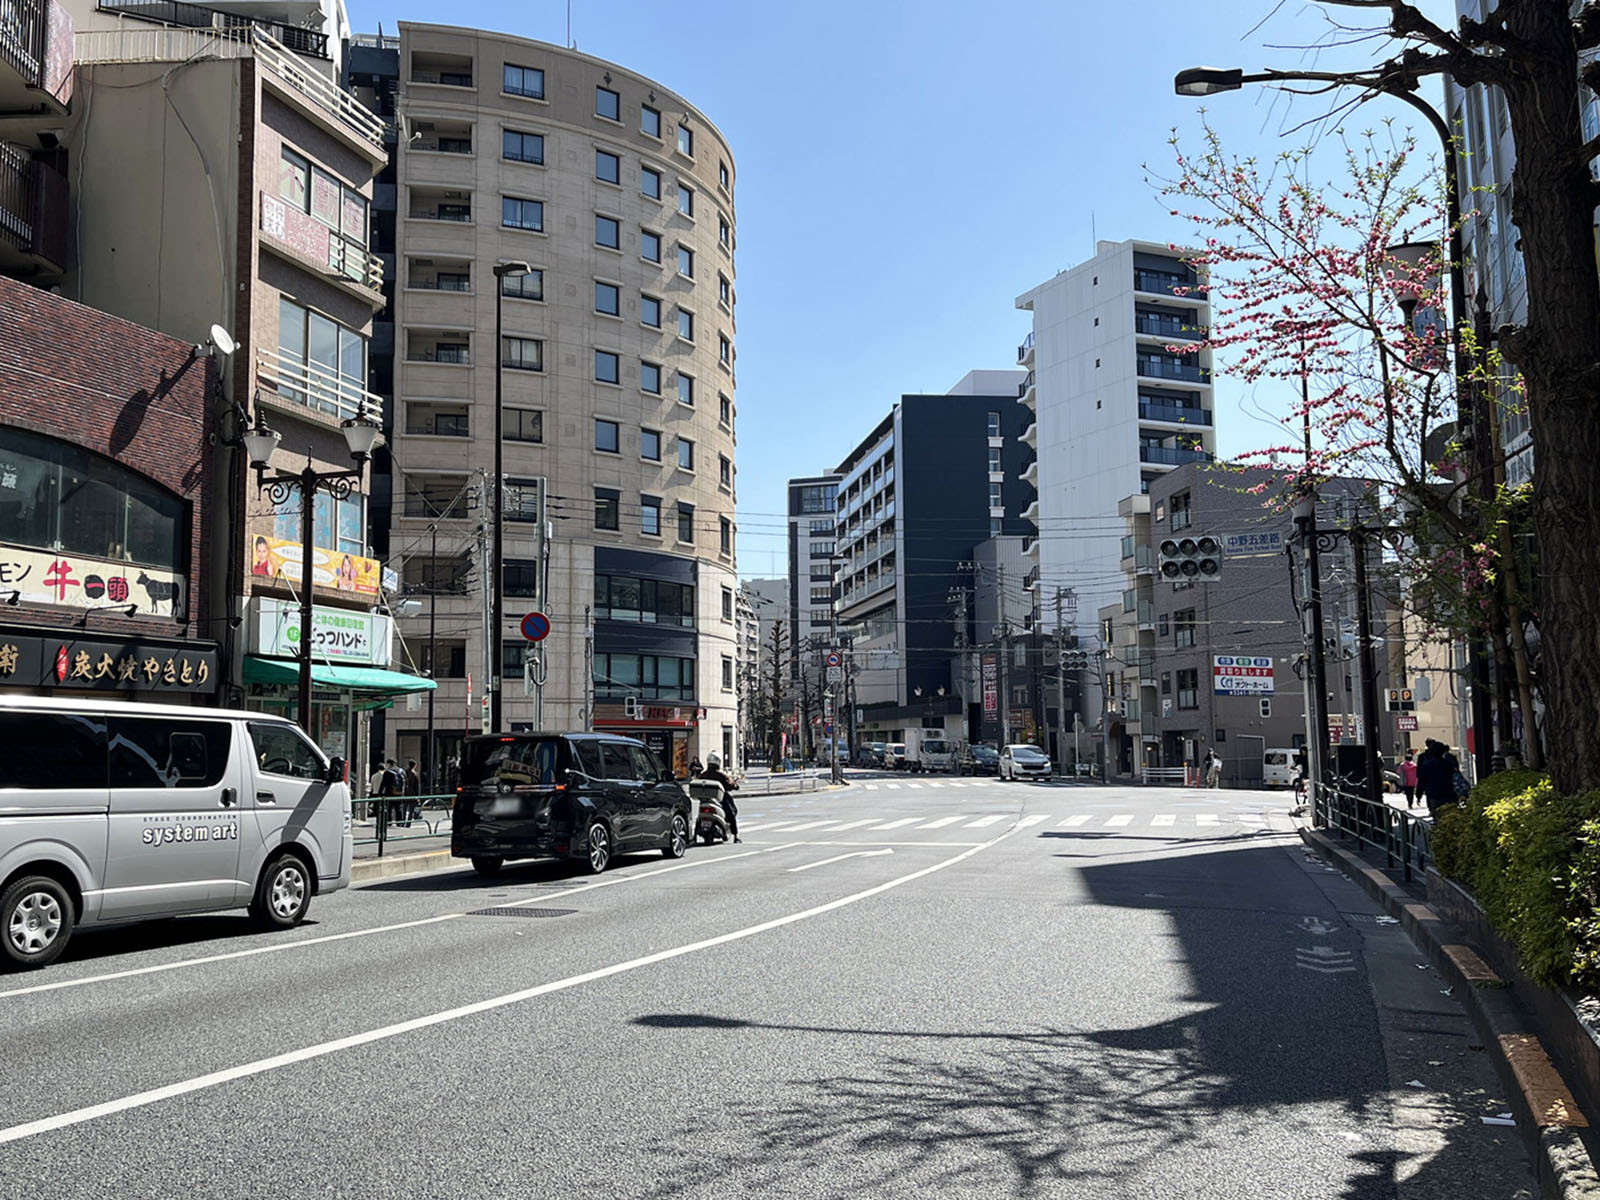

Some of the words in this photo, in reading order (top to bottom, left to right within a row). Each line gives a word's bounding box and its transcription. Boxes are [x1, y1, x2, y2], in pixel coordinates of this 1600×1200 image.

[1228, 533, 1280, 546] 中野五差路
[71, 650, 209, 684] 炭火焼やきとり
[143, 823, 209, 847] system
[212, 822, 237, 840] art
